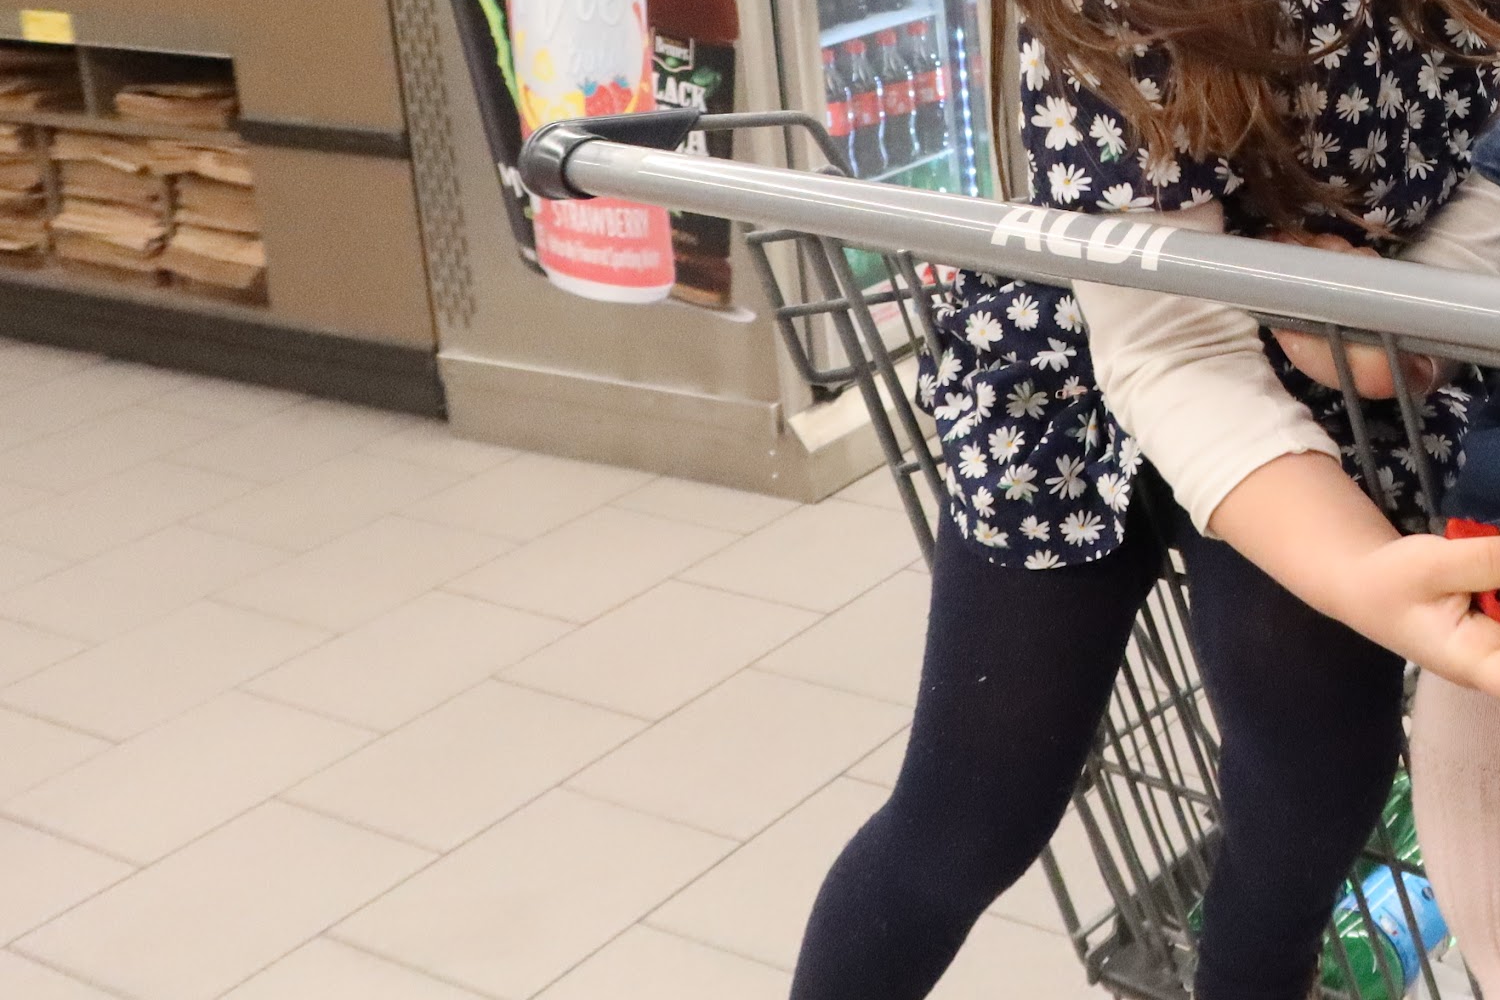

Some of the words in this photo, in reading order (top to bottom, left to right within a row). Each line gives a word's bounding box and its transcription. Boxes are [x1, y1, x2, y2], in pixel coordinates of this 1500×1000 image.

[653, 72, 709, 114] LACK
[551, 201, 649, 238] STRAWBERRY
[990, 204, 1178, 272] ALDI
